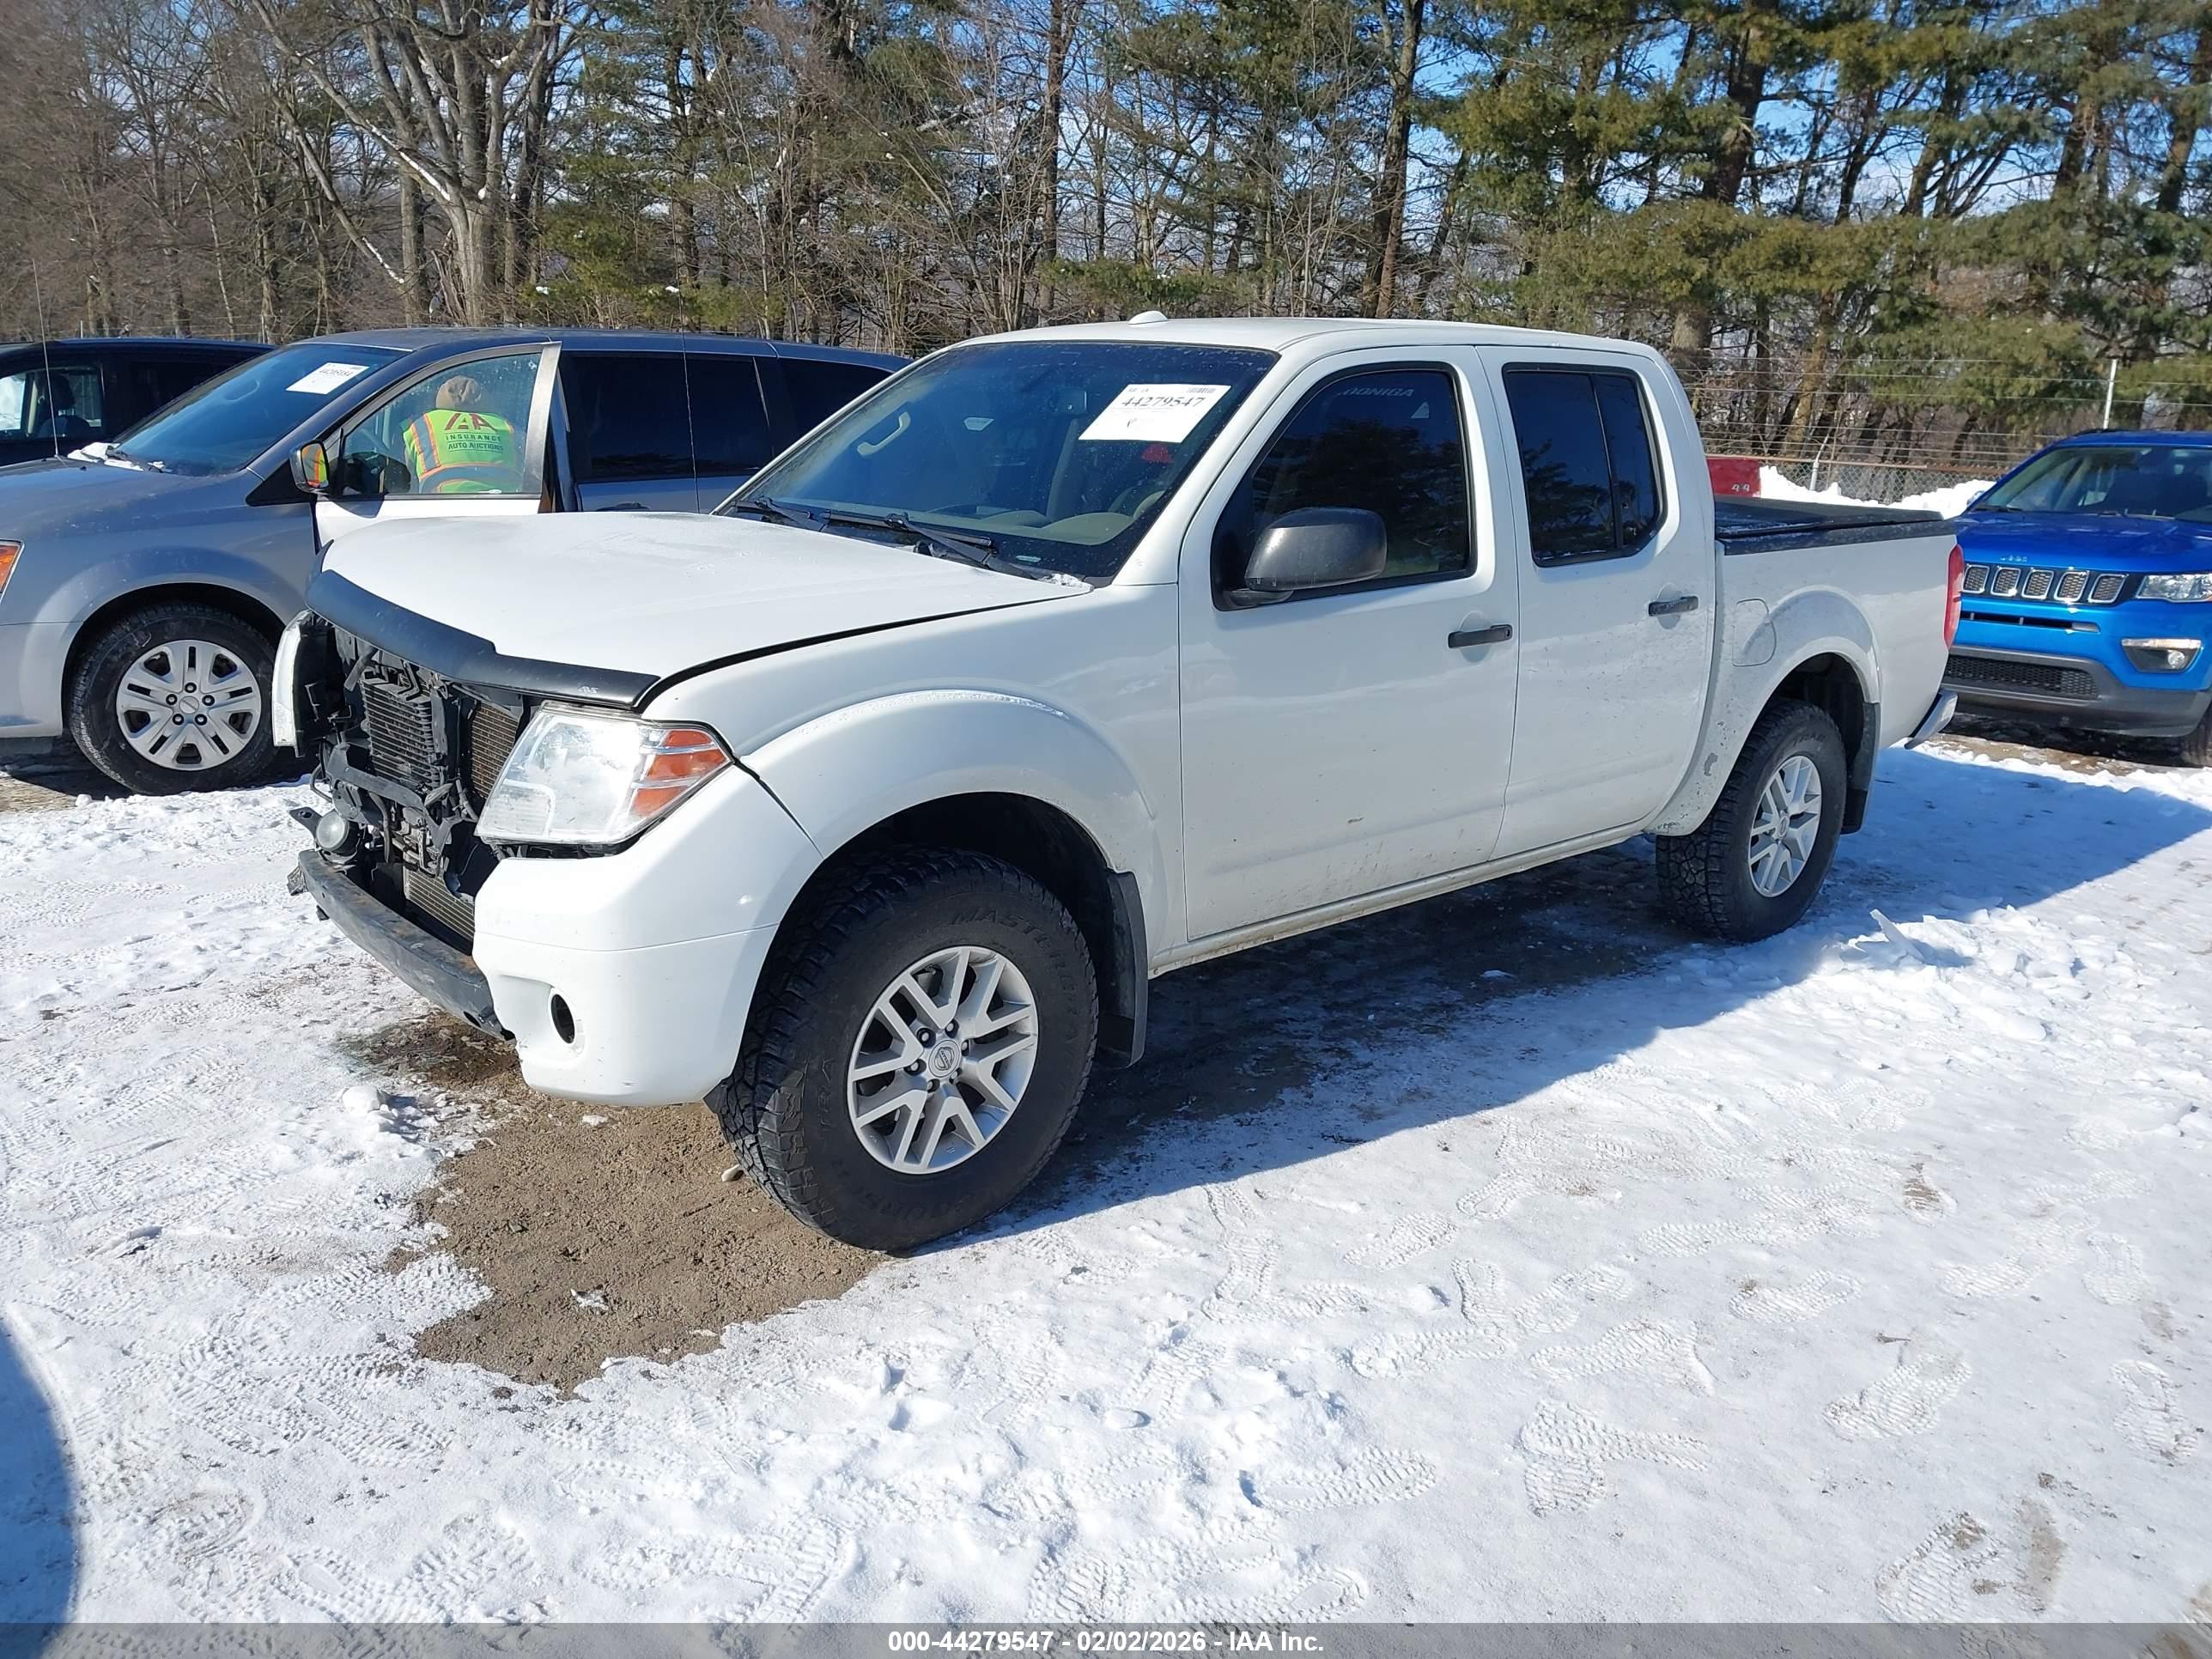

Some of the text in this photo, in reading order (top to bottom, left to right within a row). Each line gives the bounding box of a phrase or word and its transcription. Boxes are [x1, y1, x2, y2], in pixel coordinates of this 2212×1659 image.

[1121, 396, 1206, 407] 44279547
[444, 412, 498, 431] IAA
[447, 441, 504, 452] AUTO AUCTIONS
